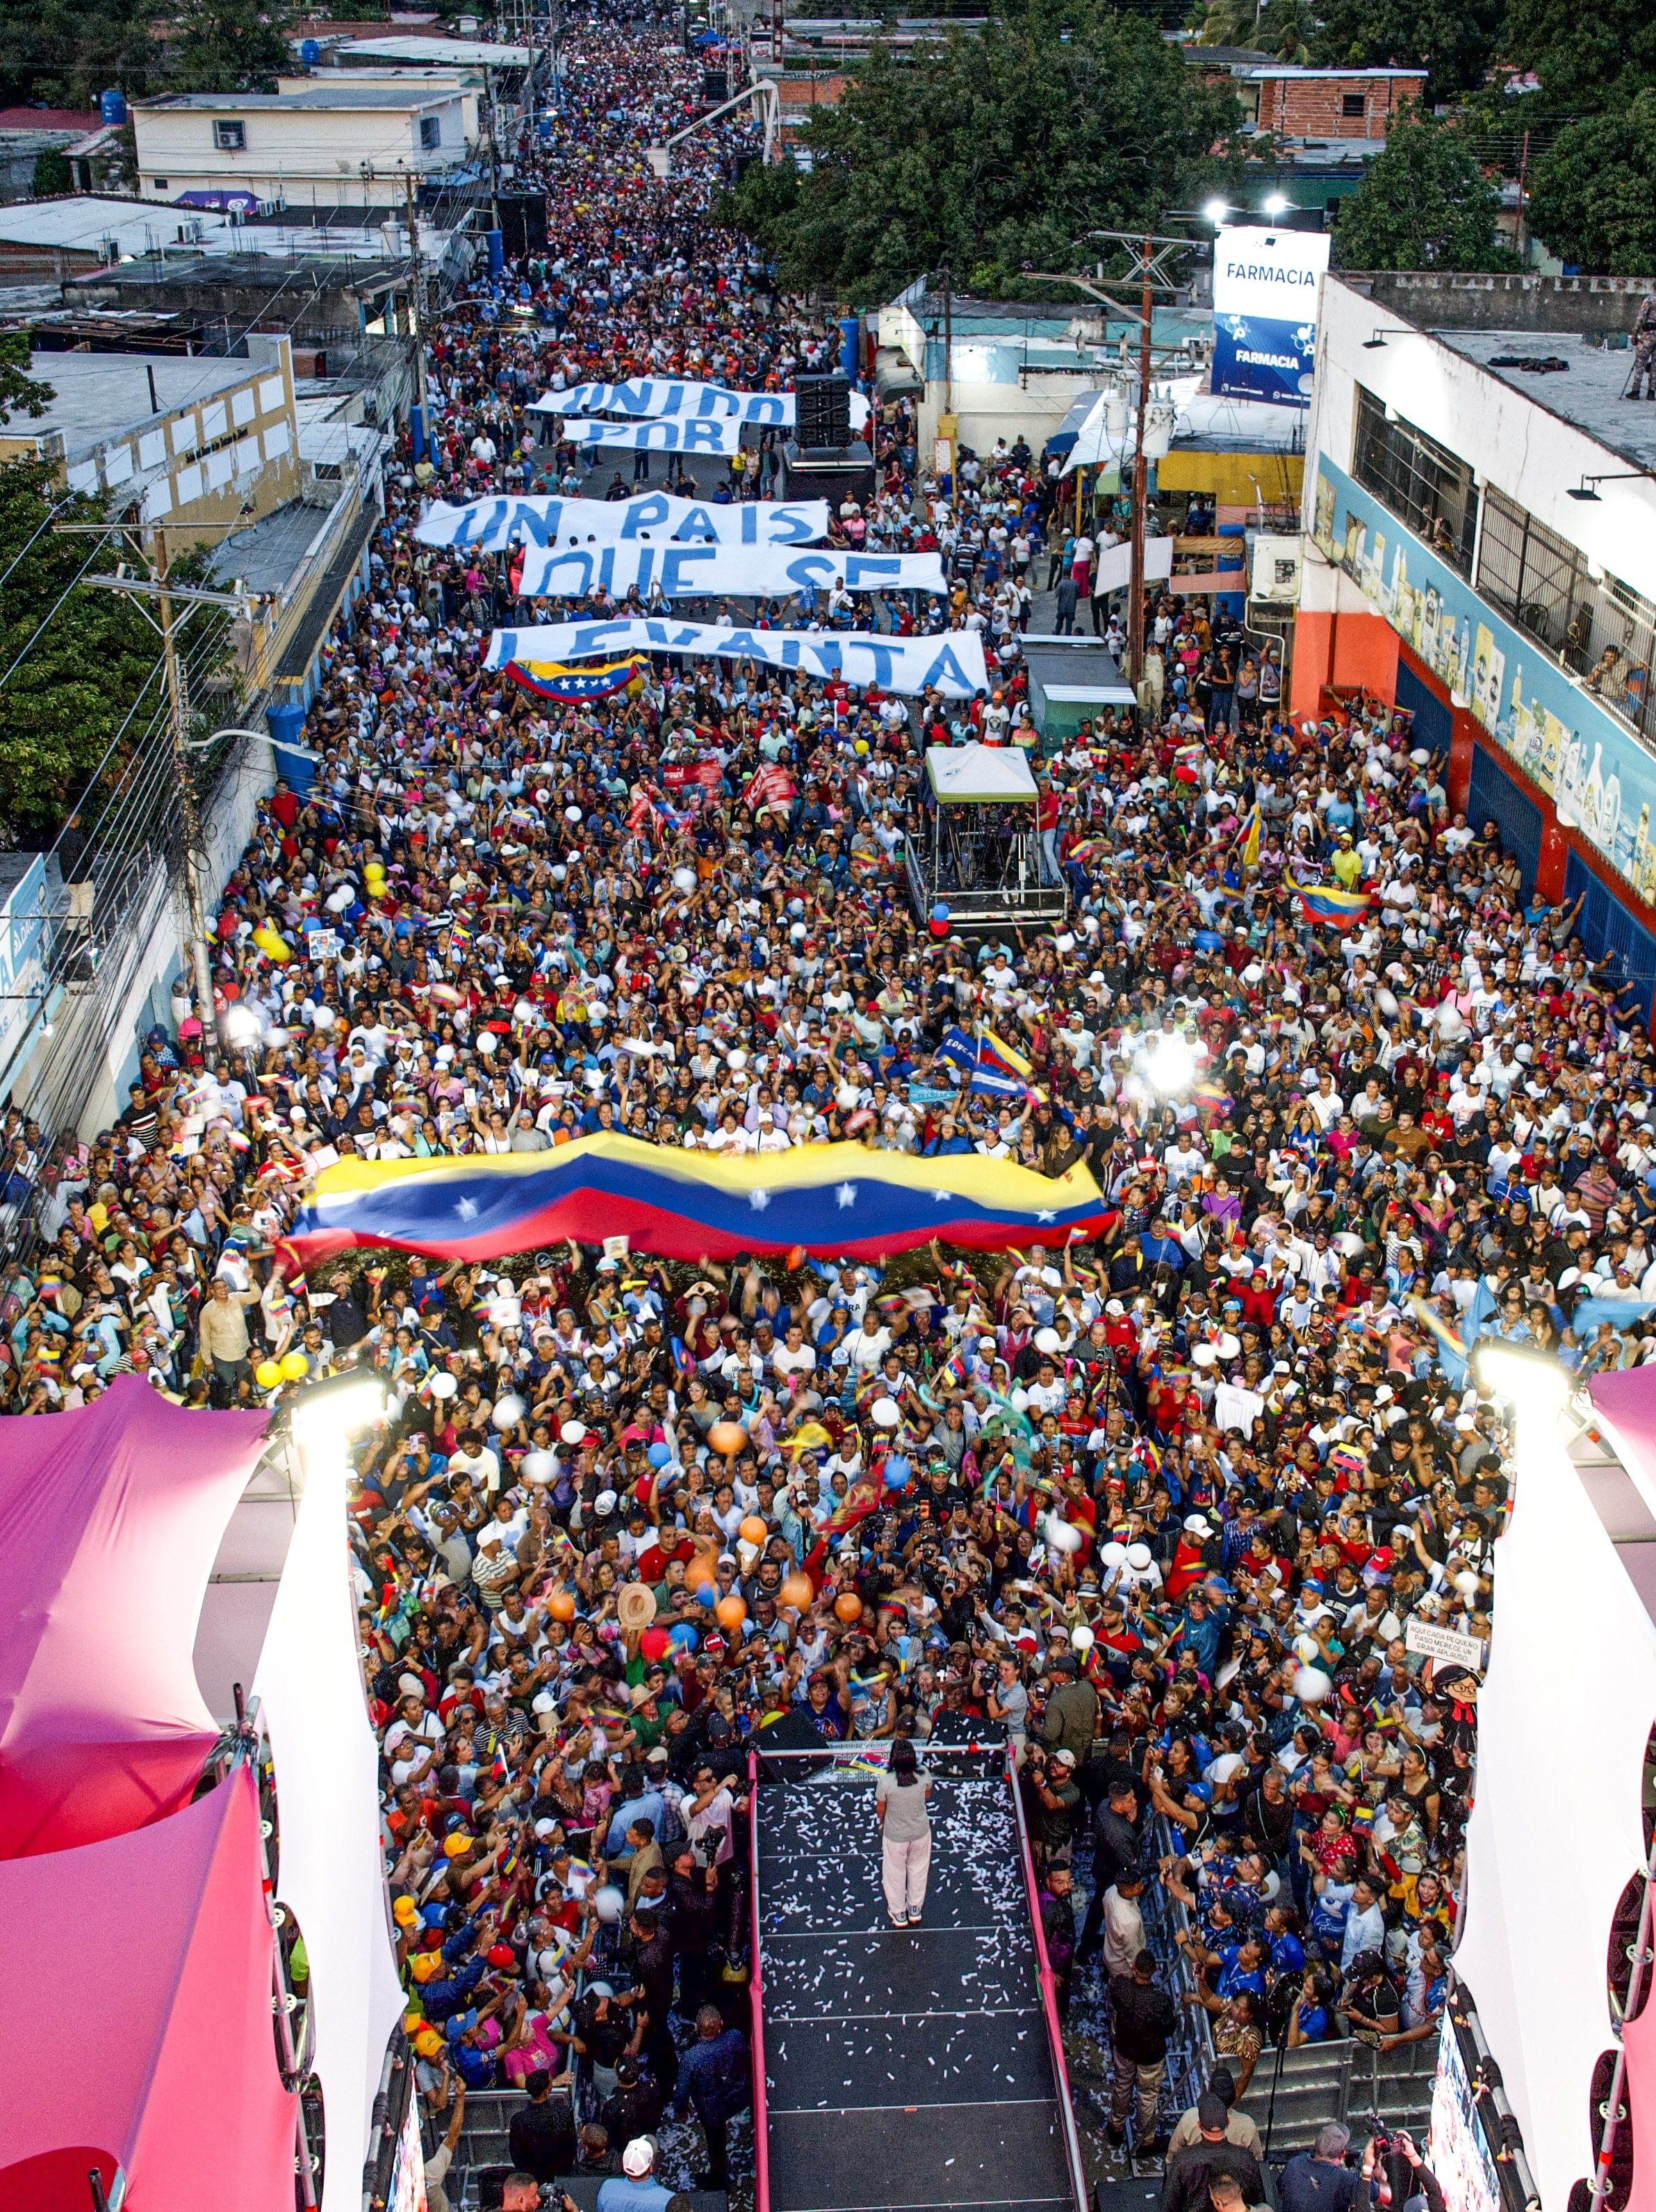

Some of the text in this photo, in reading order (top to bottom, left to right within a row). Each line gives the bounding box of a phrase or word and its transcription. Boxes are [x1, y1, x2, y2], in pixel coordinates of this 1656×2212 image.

[1227, 263, 1315, 286] FARMACIA
[1236, 350, 1299, 370] FARMACIA
[584, 418, 725, 453] POR
[453, 500, 564, 545] UN
[1414, 1634, 1433, 1644] PASO
[1434, 1639, 1461, 1653] MERECE
[1427, 1630, 1445, 1639] CADA
[1416, 1642, 1435, 1652] GRAN
